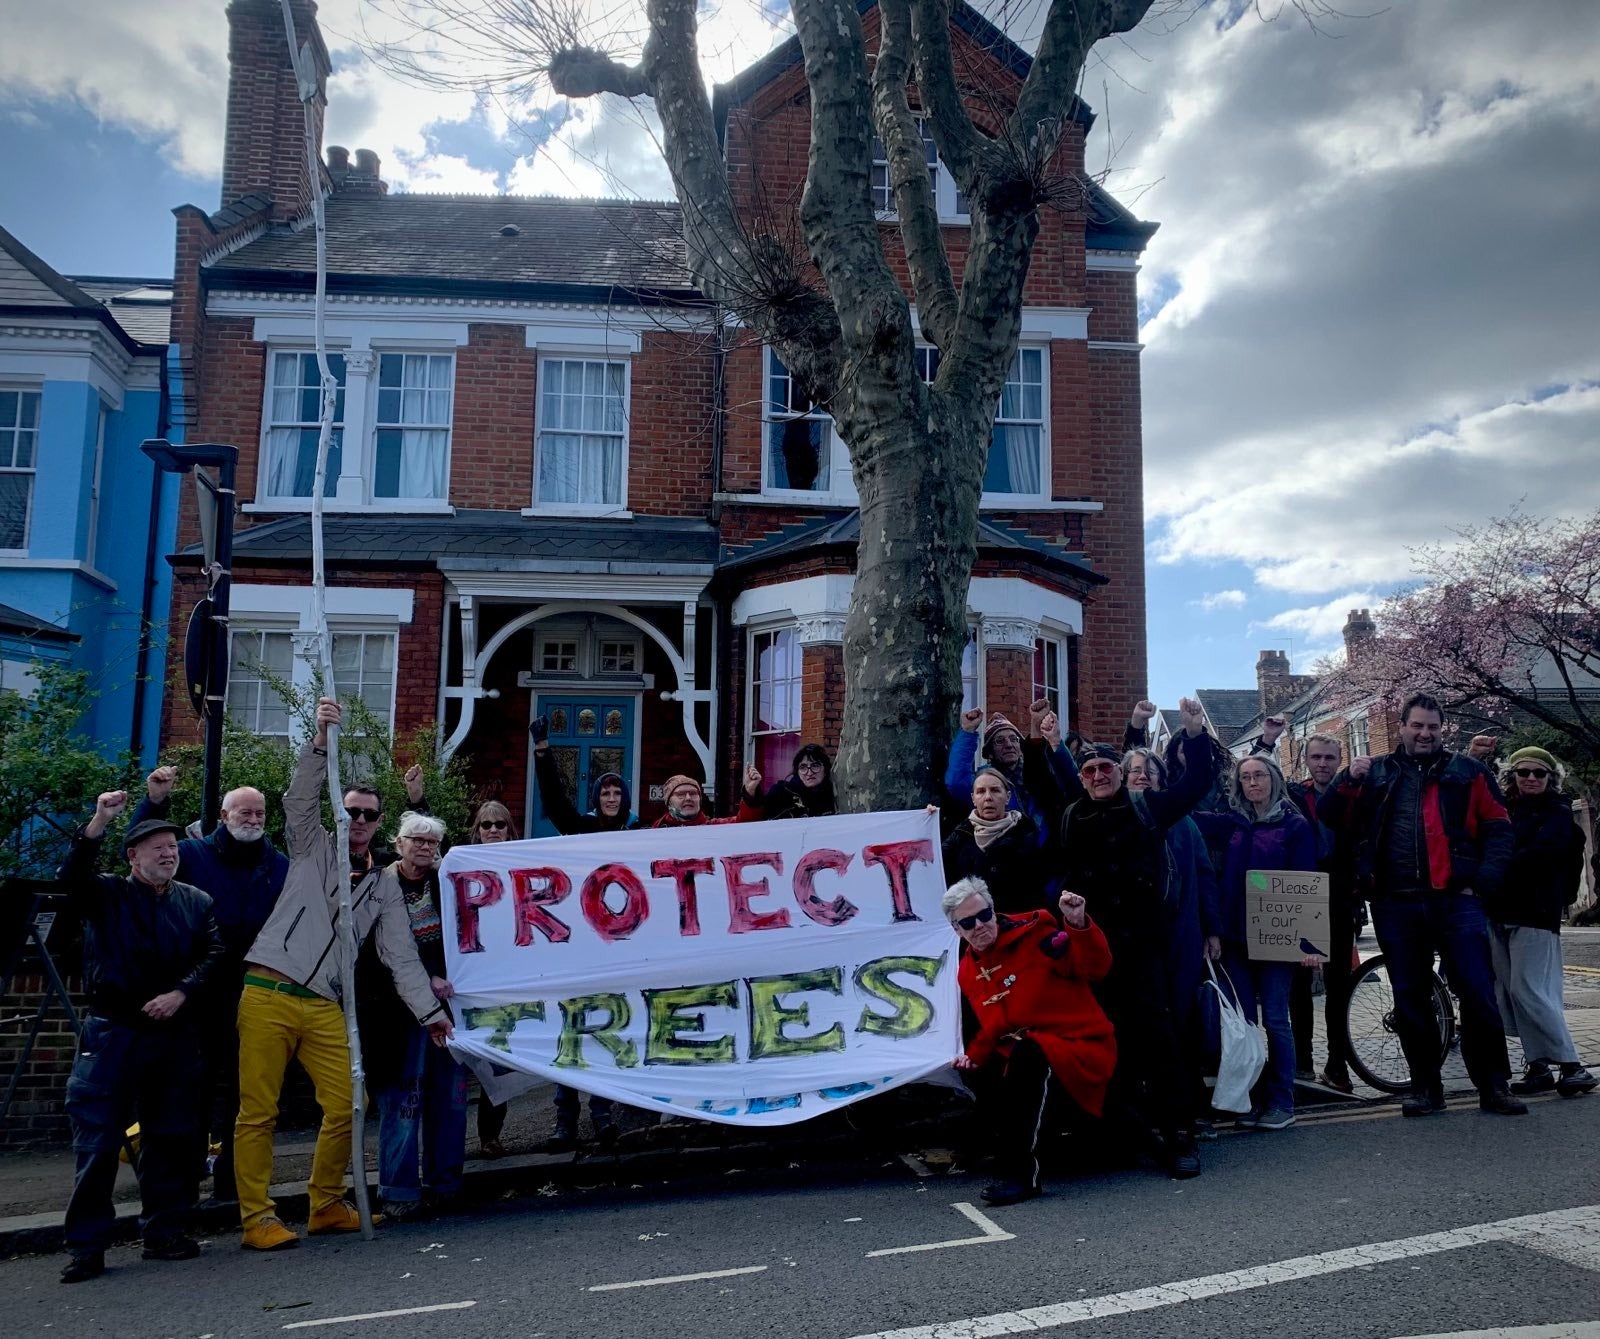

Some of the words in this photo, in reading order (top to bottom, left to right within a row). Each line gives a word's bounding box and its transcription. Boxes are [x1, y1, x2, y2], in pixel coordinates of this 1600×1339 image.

[1271, 877, 1318, 895] Please
[446, 838, 934, 954] PROTECT
[1259, 896, 1303, 914] leave
[1271, 916, 1298, 928] our
[1259, 928, 1298, 946] trees!
[461, 949, 949, 1070] TREES
